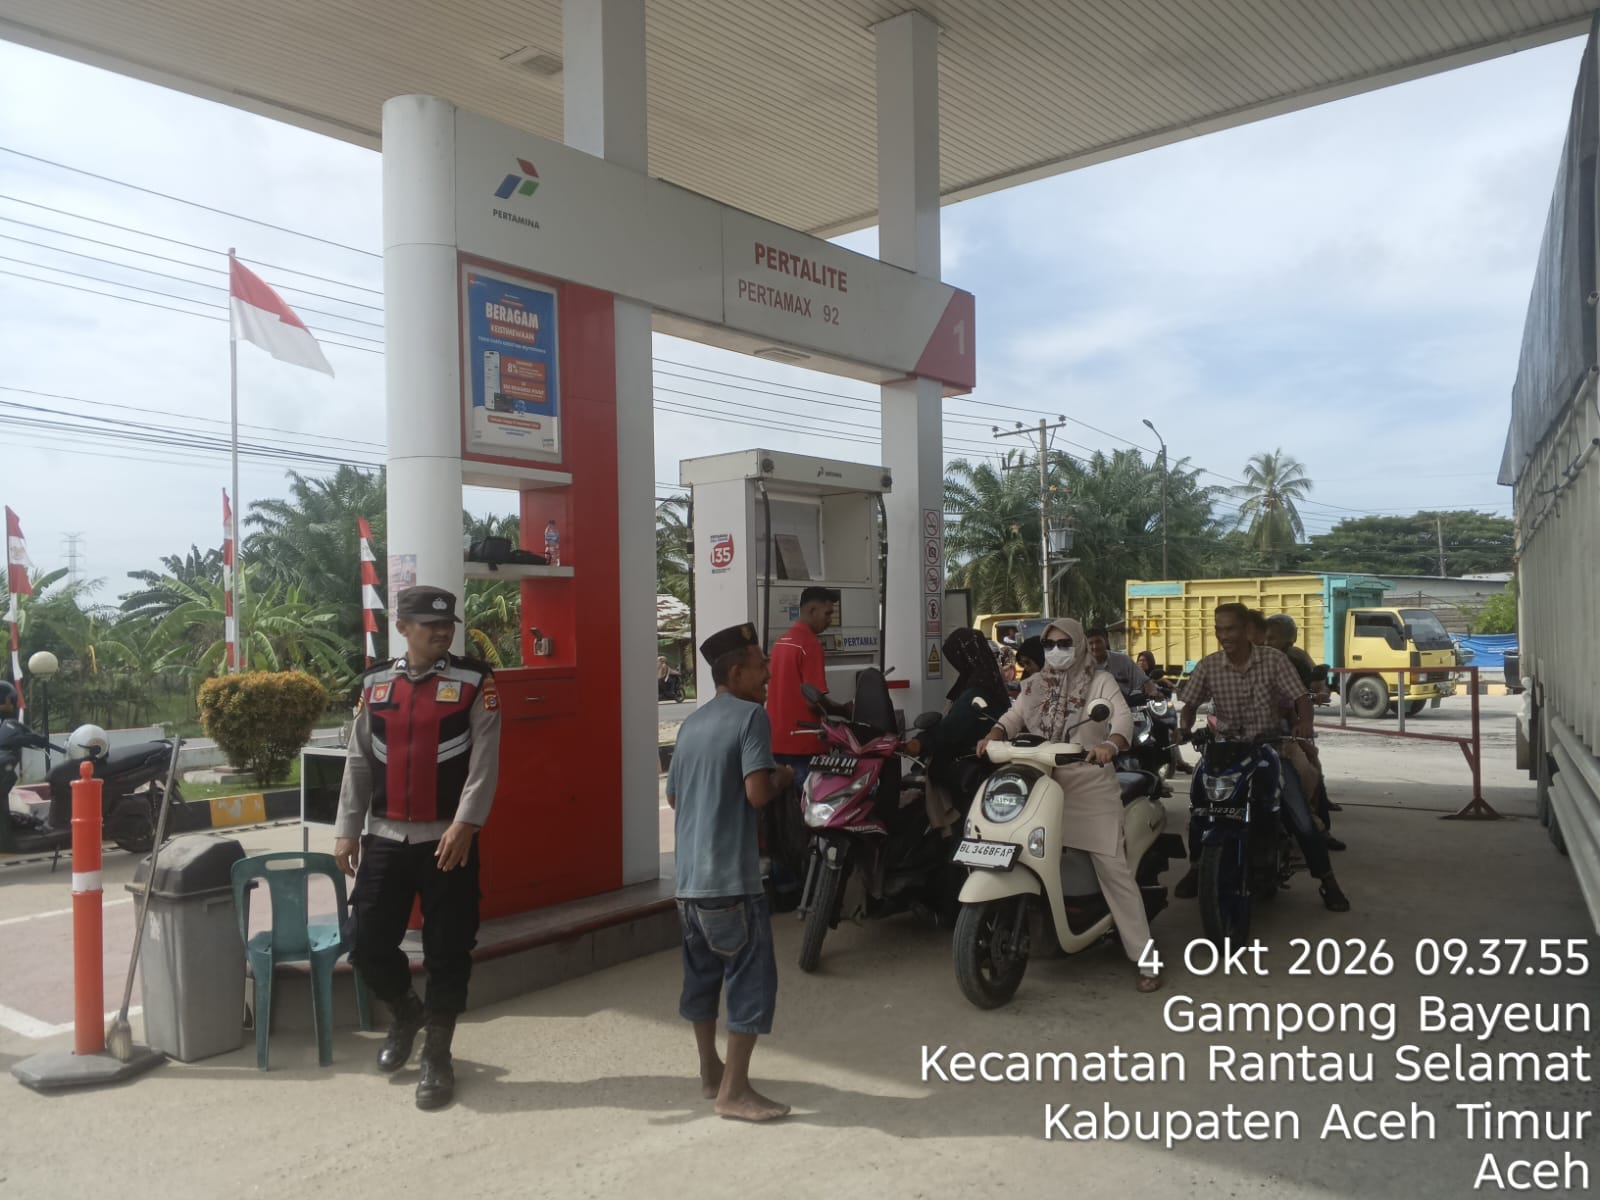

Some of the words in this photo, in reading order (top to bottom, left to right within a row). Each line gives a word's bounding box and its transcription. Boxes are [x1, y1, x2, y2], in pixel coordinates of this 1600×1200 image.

[493, 208, 540, 229] PERTAMINA
[754, 242, 848, 292] PERTALITE
[738, 279, 812, 318] PERTAMAX
[823, 304, 840, 325] 92
[485, 302, 539, 329] BERAGAM
[953, 319, 966, 354] 1
[712, 546, 731, 563] 135
[843, 636, 878, 648] PERTAMAX
[960, 843, 970, 854] BL
